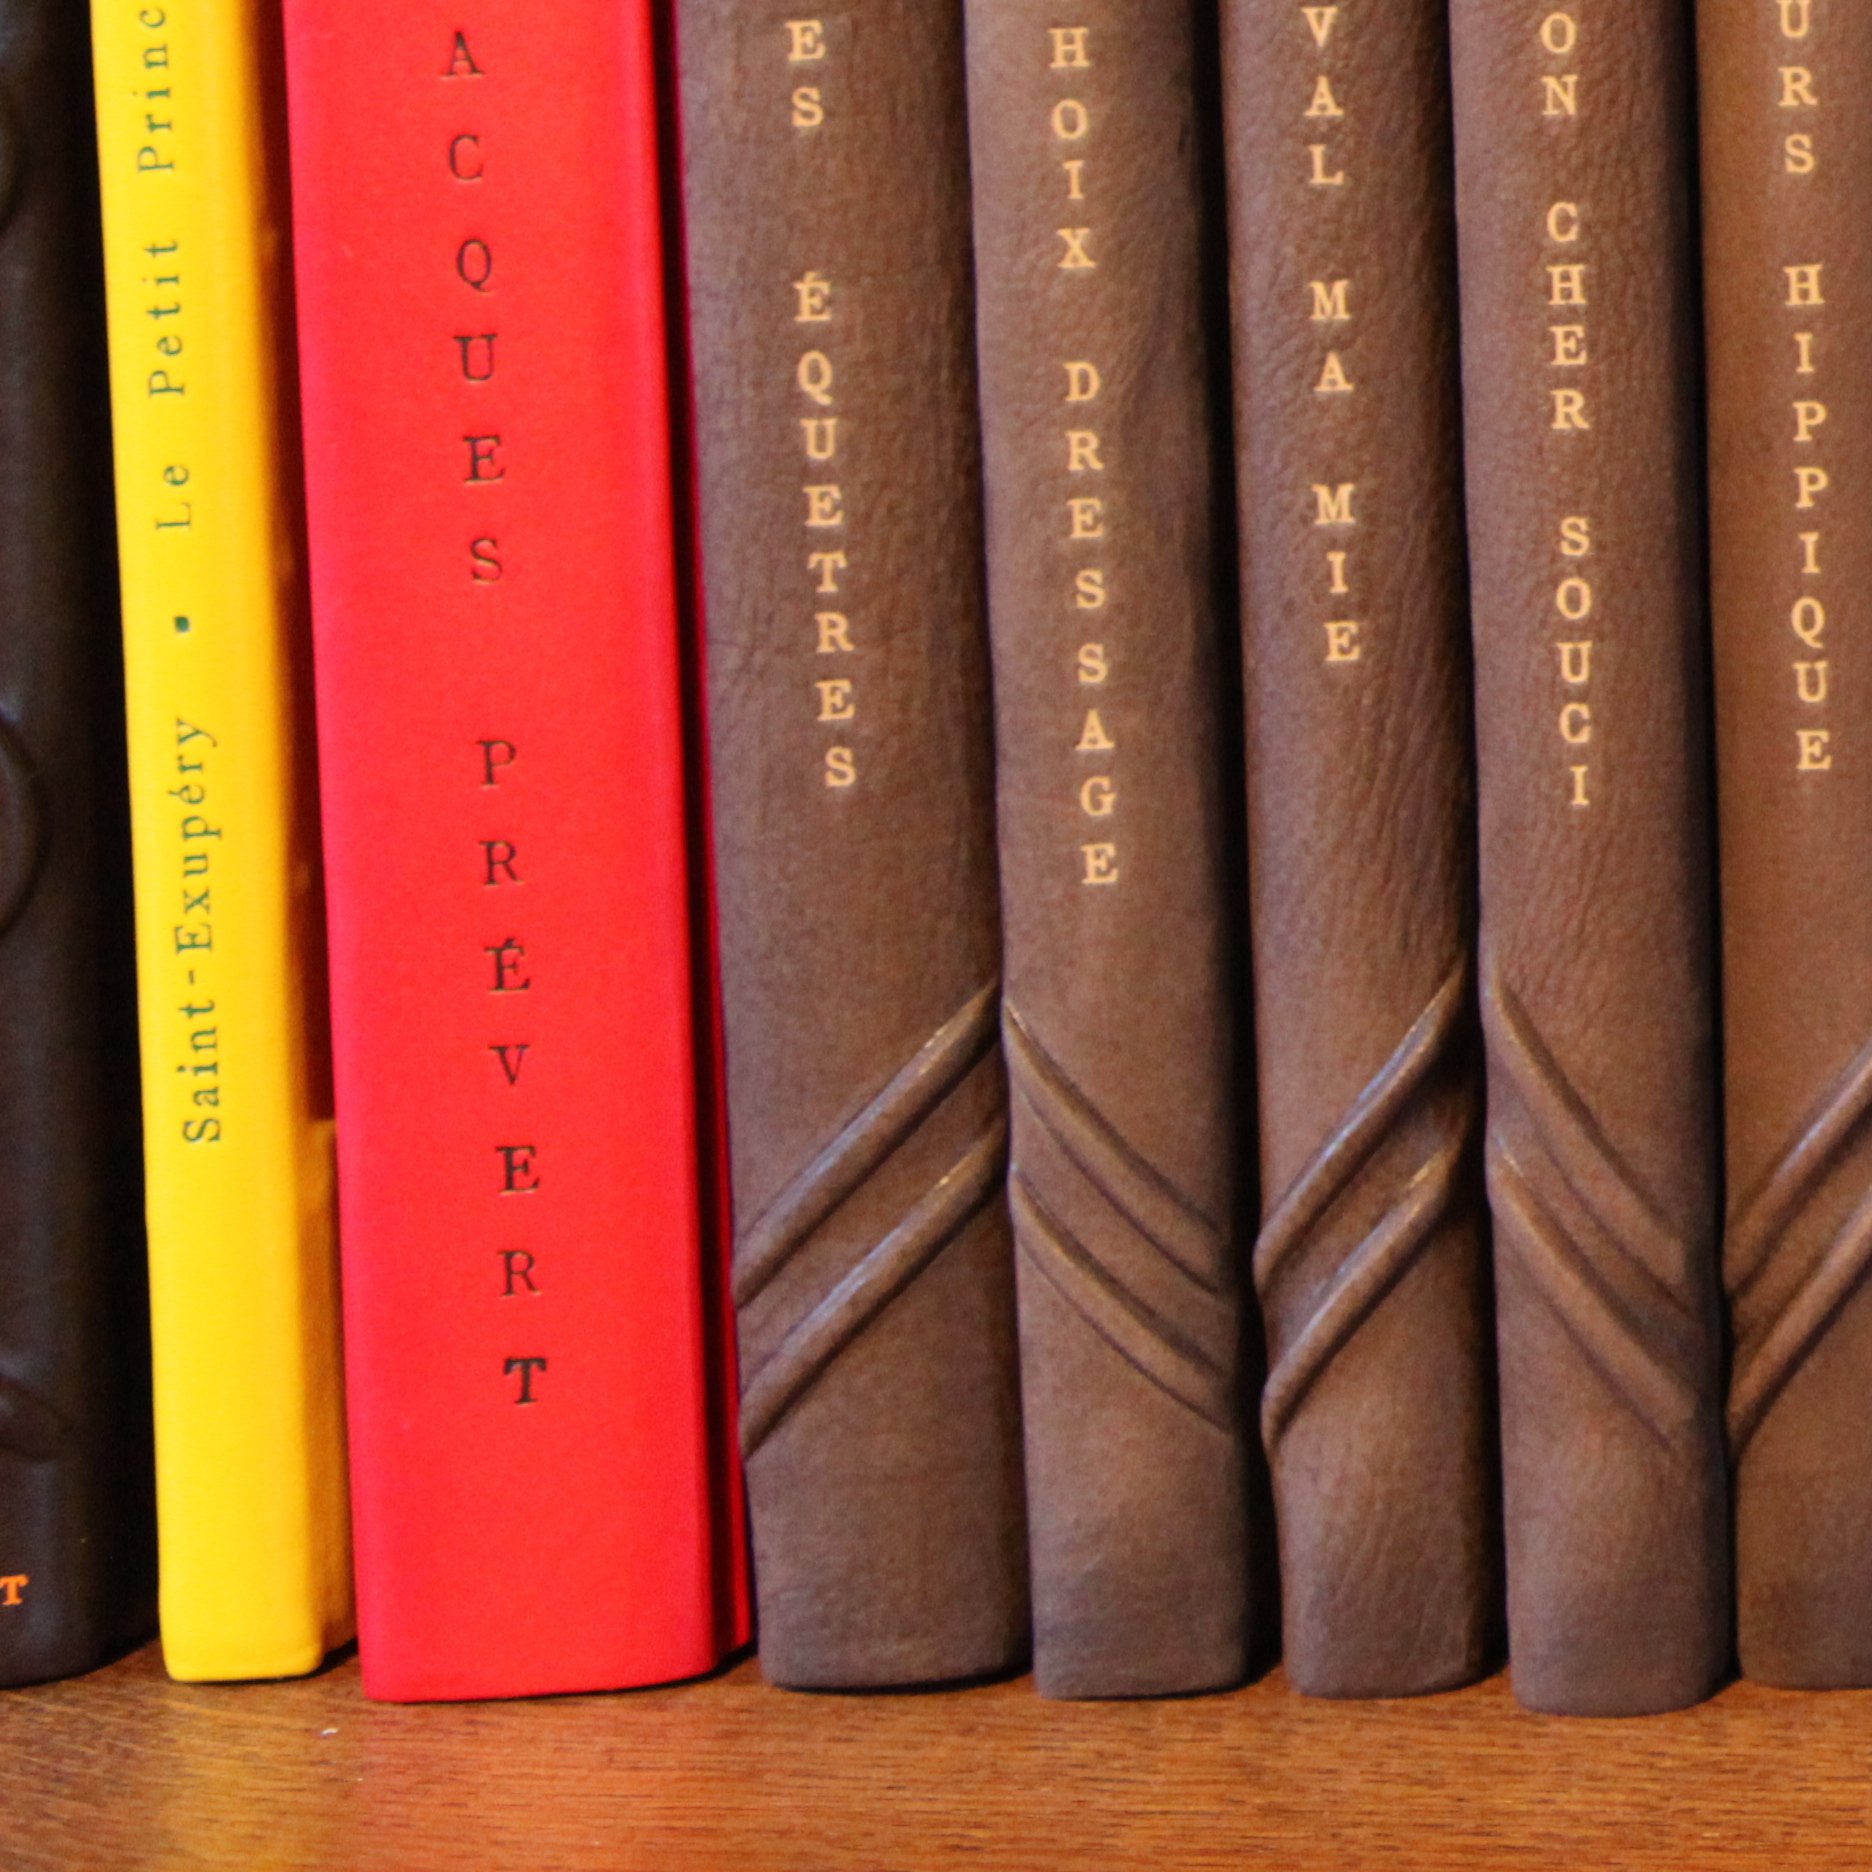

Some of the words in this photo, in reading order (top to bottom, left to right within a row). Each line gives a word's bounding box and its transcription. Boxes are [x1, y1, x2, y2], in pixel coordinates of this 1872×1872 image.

[141, 238, 187, 398] Petit
[1309, 280, 1354, 392] MA
[1547, 202, 1591, 431] CHER
[155, 463, 192, 531] Le
[793, 272, 857, 788] ÉQUETRES
[1064, 362, 1118, 886] DRESSAGE
[1314, 483, 1360, 663] MIE
[1784, 265, 1832, 772] HIPPIQUE
[1554, 516, 1592, 807] SOUCI
[168, 717, 223, 1143] Saint-Exupéry
[476, 737, 548, 1406] PRÉVERT
